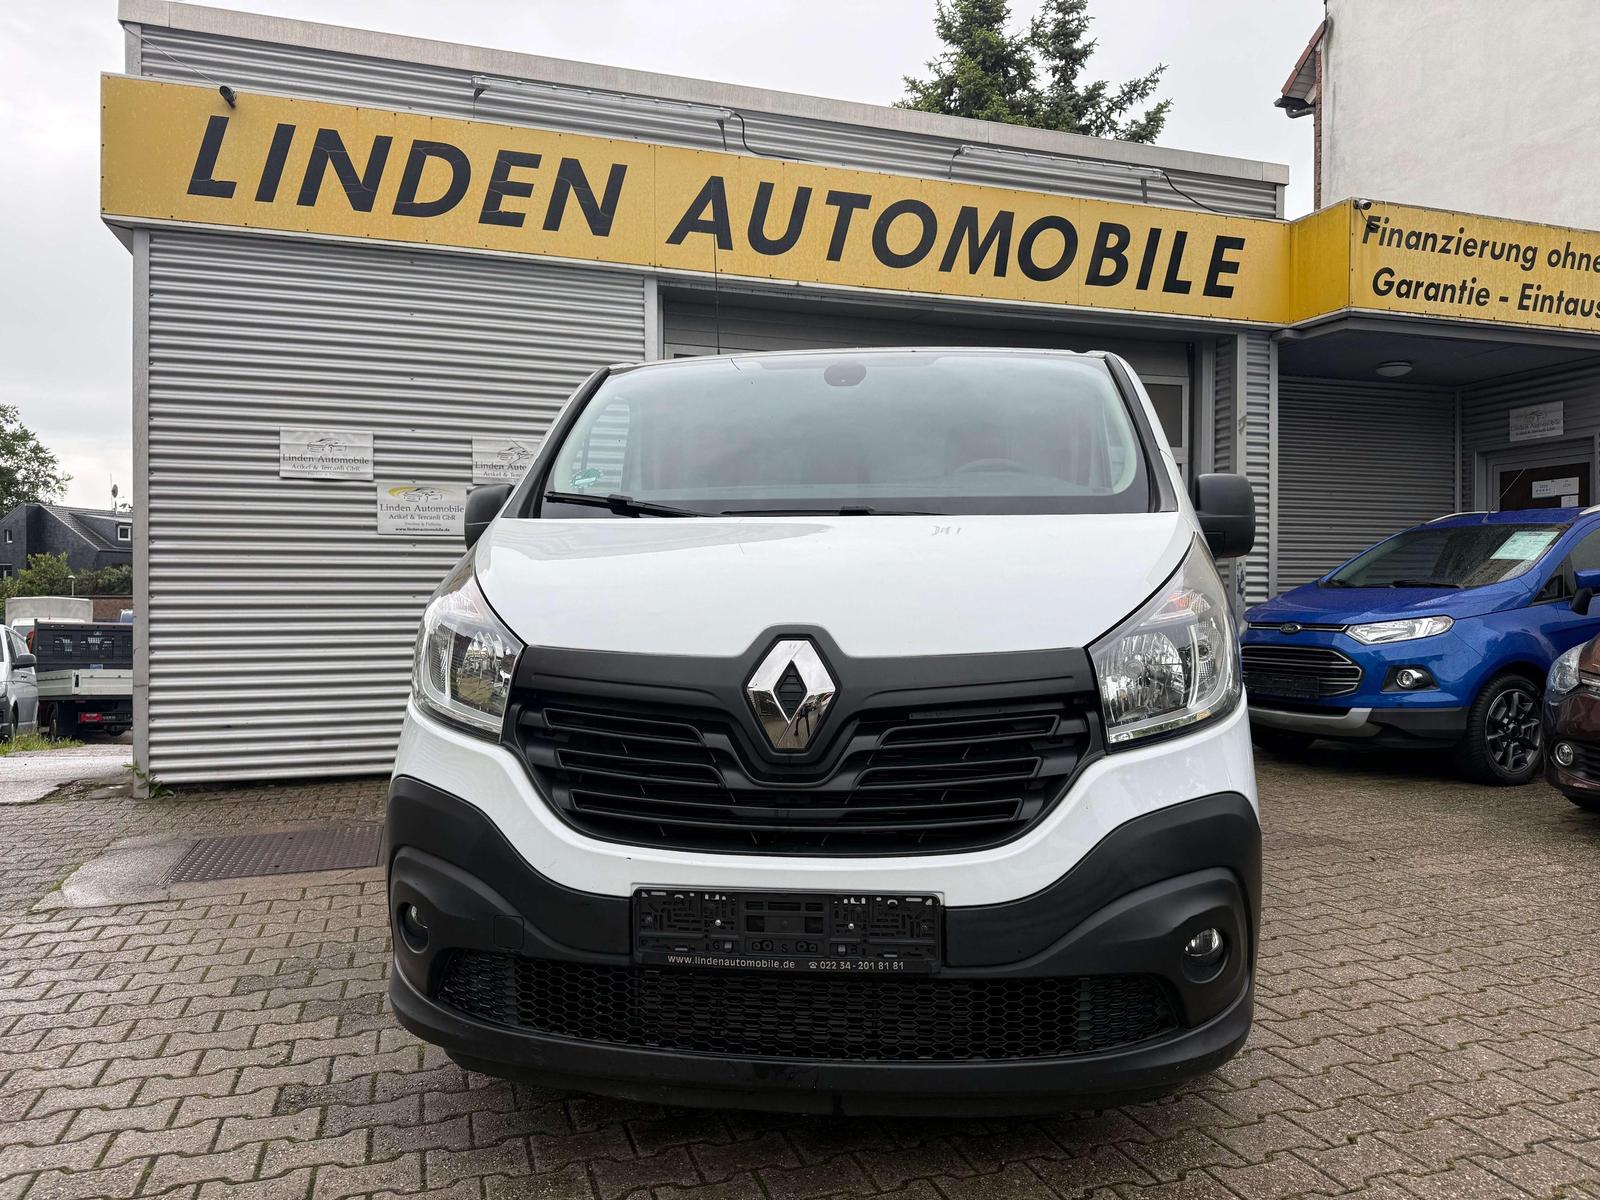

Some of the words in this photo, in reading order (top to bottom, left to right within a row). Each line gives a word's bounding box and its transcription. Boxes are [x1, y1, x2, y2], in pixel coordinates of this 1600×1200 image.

[187, 115, 628, 237] LINDEN
[665, 175, 1246, 298] AUTOMOBILE
[1362, 214, 1539, 271] Finanzierung
[1372, 266, 1490, 306] Garantie
[1498, 295, 1509, 303] -
[283, 453, 314, 463] Linden
[317, 455, 370, 465] Automobile
[475, 461, 504, 470] Linden
[380, 503, 411, 512] Linden
[414, 504, 465, 513] Automobile
[667, 955, 796, 969] www.lindenautomobile.de
[820, 961, 837, 970] 022
[858, 961, 875, 970] 201
[878, 961, 889, 970] 81
[892, 961, 904, 970] 81
